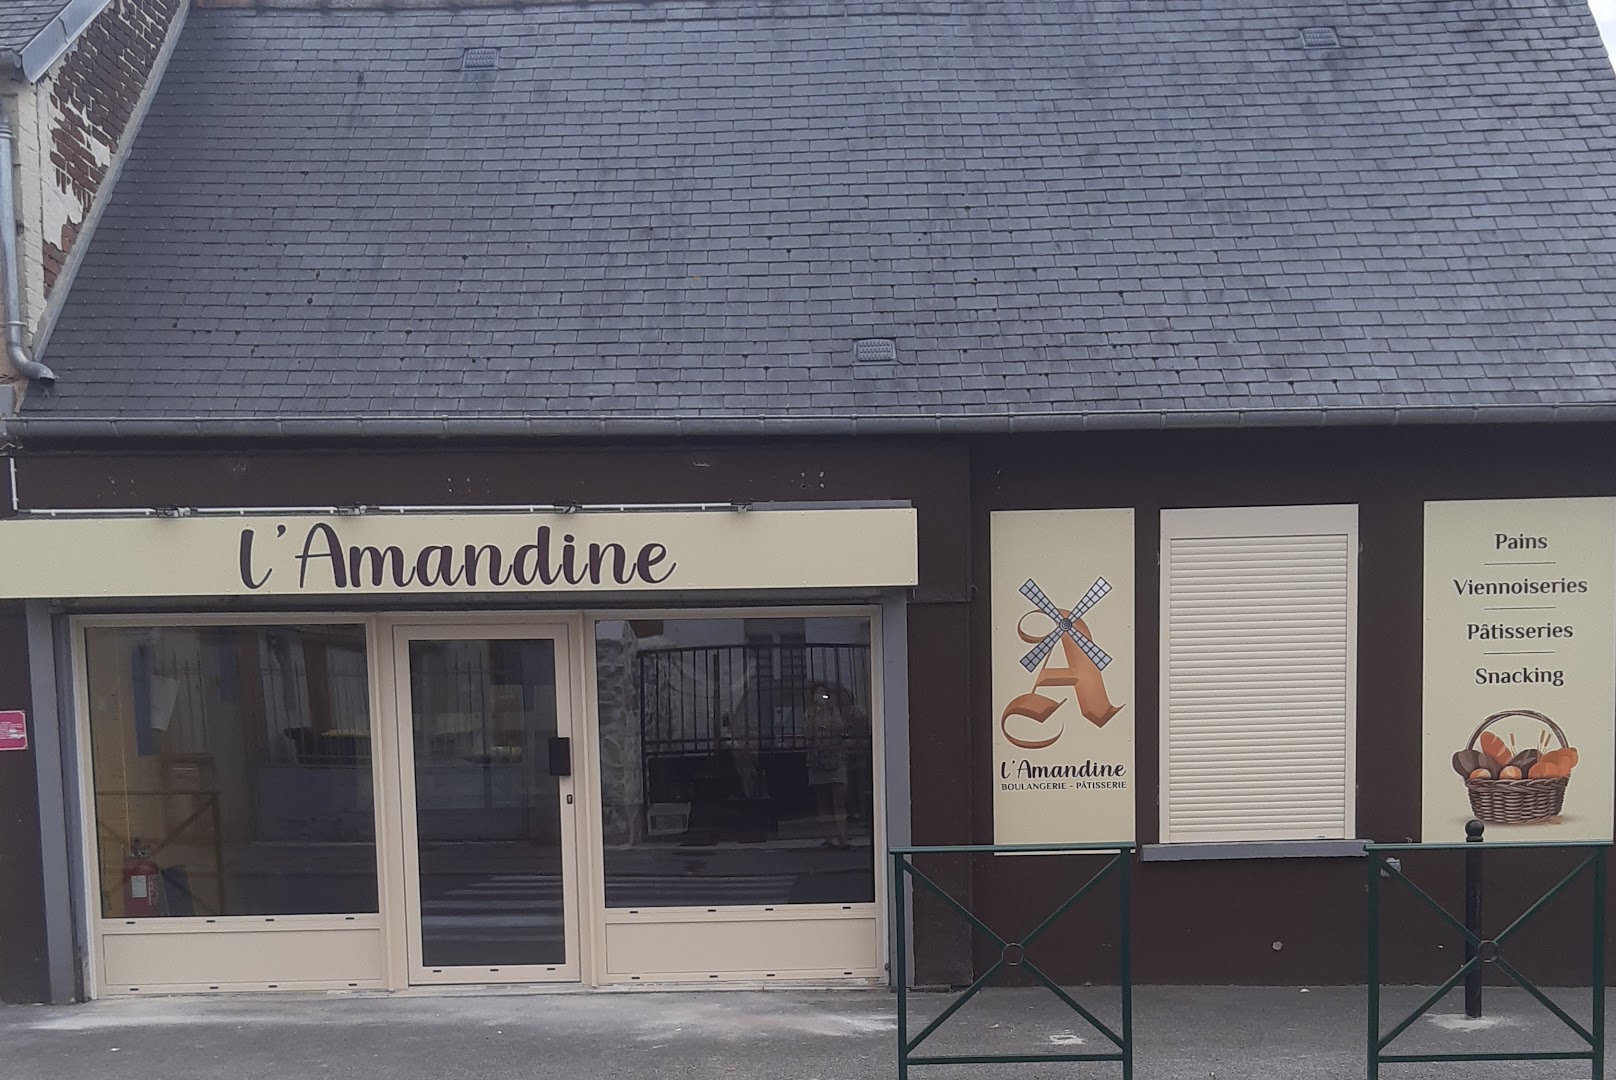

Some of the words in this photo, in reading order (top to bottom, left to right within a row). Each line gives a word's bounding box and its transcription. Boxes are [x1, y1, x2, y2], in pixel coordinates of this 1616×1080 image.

[1494, 533, 1548, 550] Pains
[1453, 577, 1588, 596] Viennoiseries
[1467, 622, 1574, 640] Pâtisseries
[1475, 667, 1564, 687] Snacking
[1001, 782, 1067, 791] BOULANGERIE
[1076, 780, 1127, 789] PÂTISSERIE
